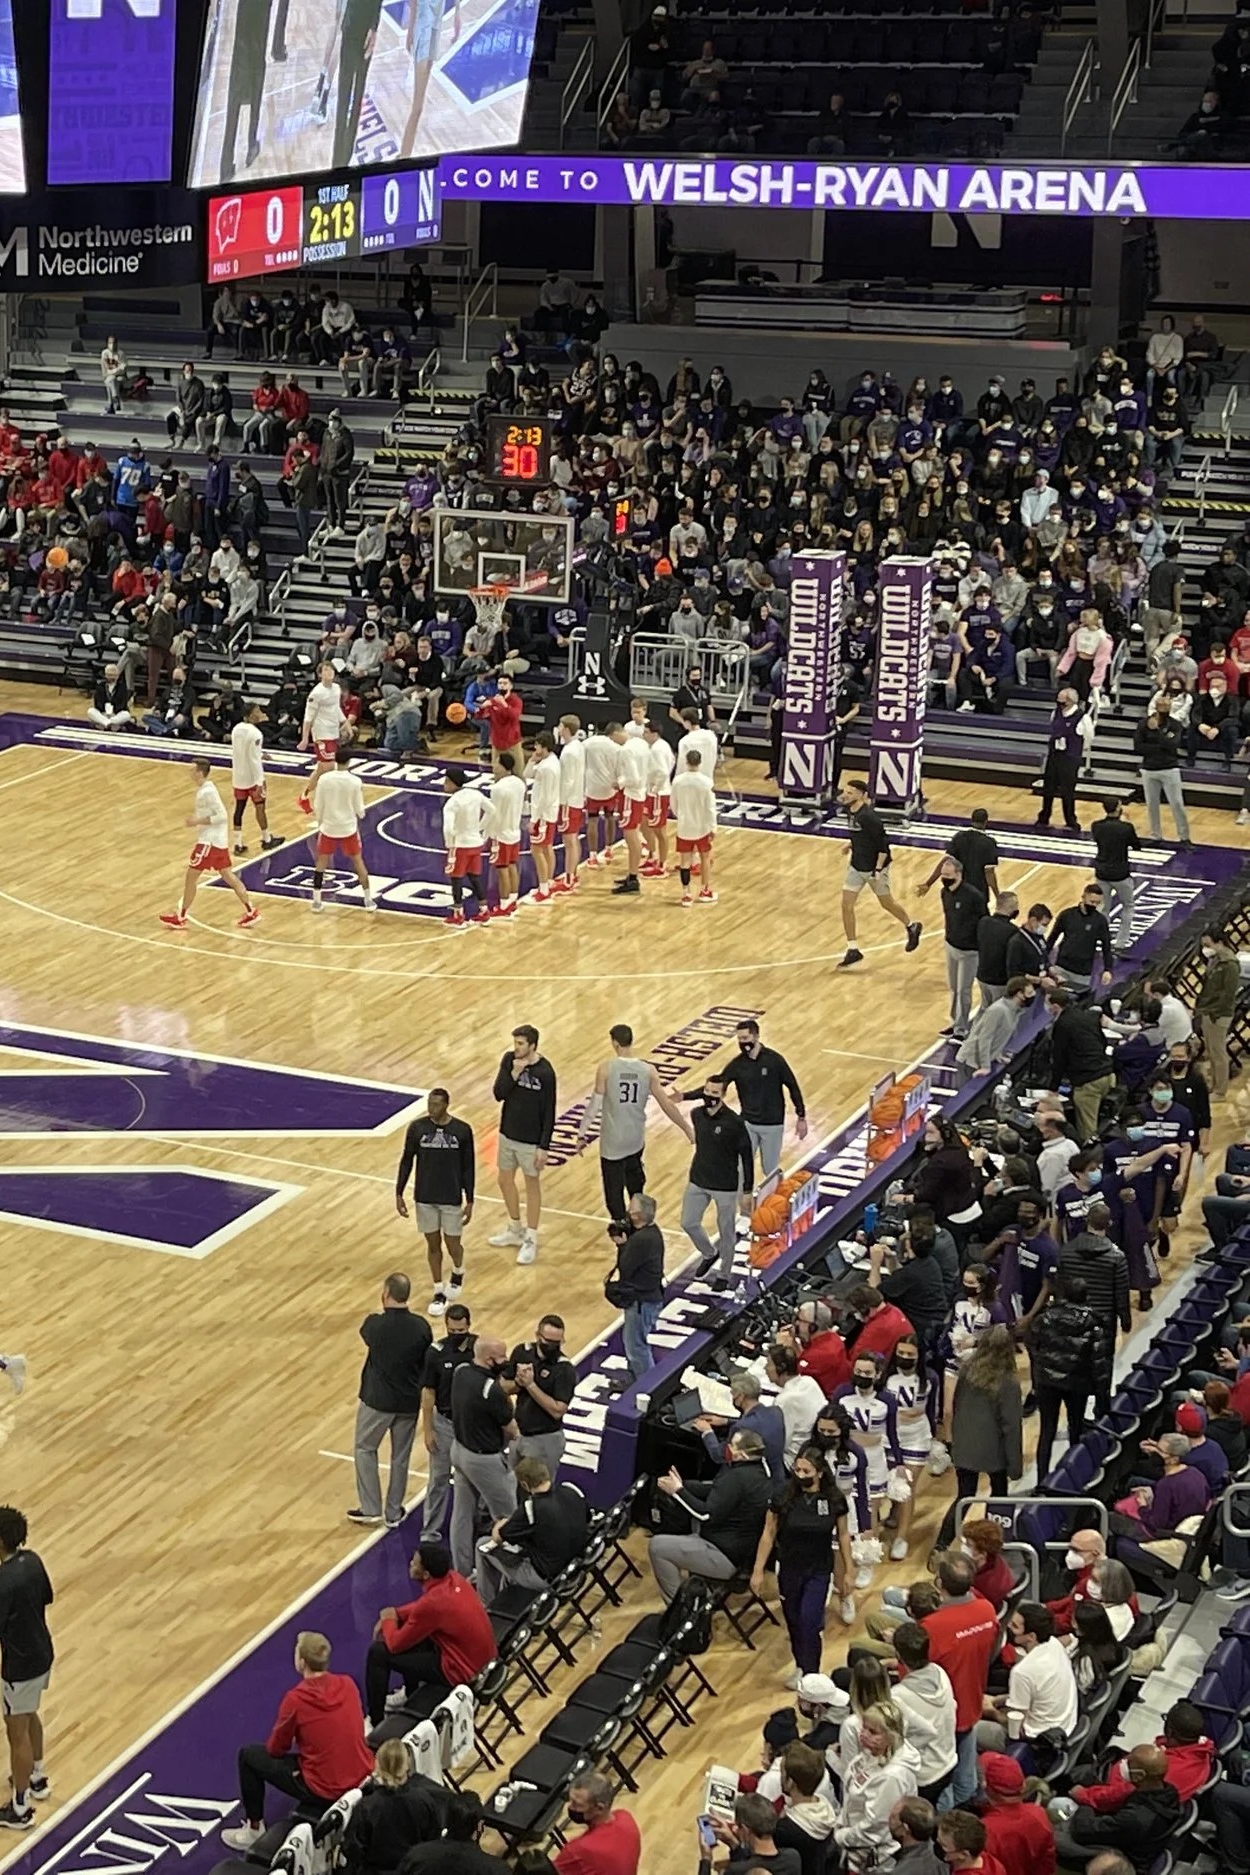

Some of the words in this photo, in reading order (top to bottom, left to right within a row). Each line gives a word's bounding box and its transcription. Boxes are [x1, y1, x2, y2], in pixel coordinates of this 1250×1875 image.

[384, 178, 400, 226] 0
[418, 168, 434, 223] N
[559, 171, 600, 190] TO
[623, 161, 950, 209] WELSH-RYAN
[959, 168, 1147, 213] ARENA
[38, 215, 193, 250] Northwestern
[266, 196, 284, 245] 0
[309, 199, 356, 245] 2:13
[506, 425, 543, 446] 2:13
[502, 444, 538, 480] 30
[584, 652, 601, 676] N
[785, 578, 819, 714] WILDCATS
[877, 584, 912, 723] WILDCATS
[782, 741, 816, 789] N
[876, 751, 910, 797] N
[619, 1082, 638, 1103] 31
